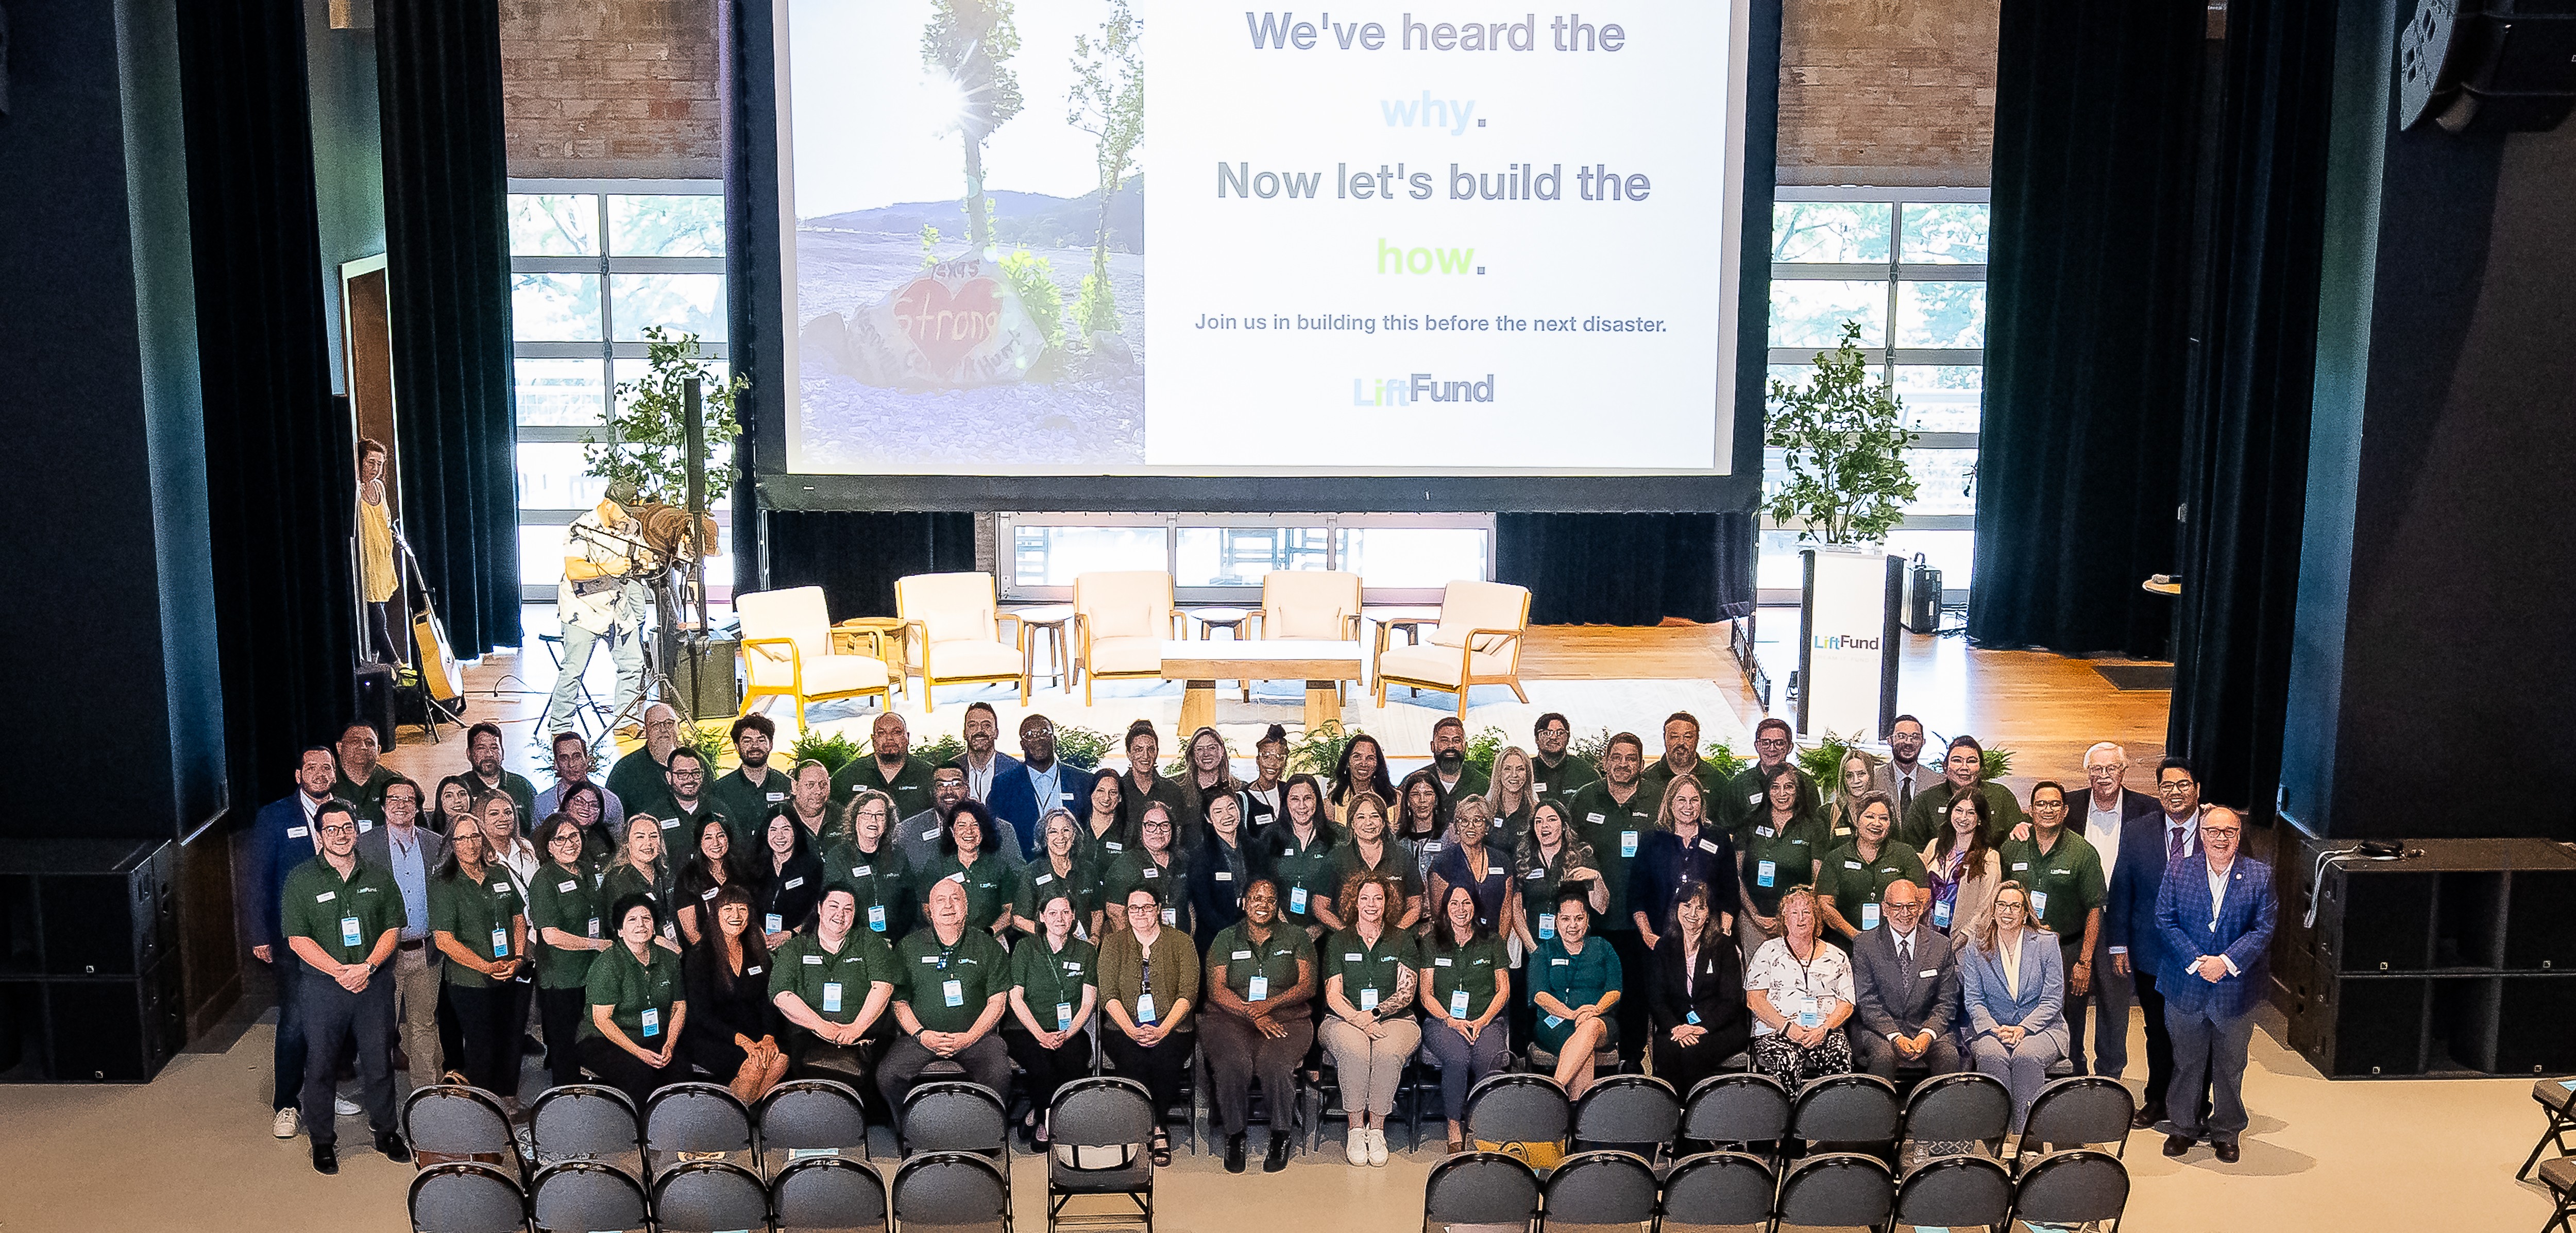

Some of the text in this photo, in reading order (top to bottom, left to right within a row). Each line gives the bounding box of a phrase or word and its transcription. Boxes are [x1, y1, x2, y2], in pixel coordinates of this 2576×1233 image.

[1246, 12, 1625, 52] We've heard the
[1381, 90, 1486, 135] why.
[1218, 162, 1651, 201] Now let's build the
[1378, 238, 1486, 275] how.
[1195, 314, 1666, 334] Join us in building this before the next disaster.
[1354, 373, 1495, 406] LiftFund
[1815, 635, 1879, 650] LiftFund
